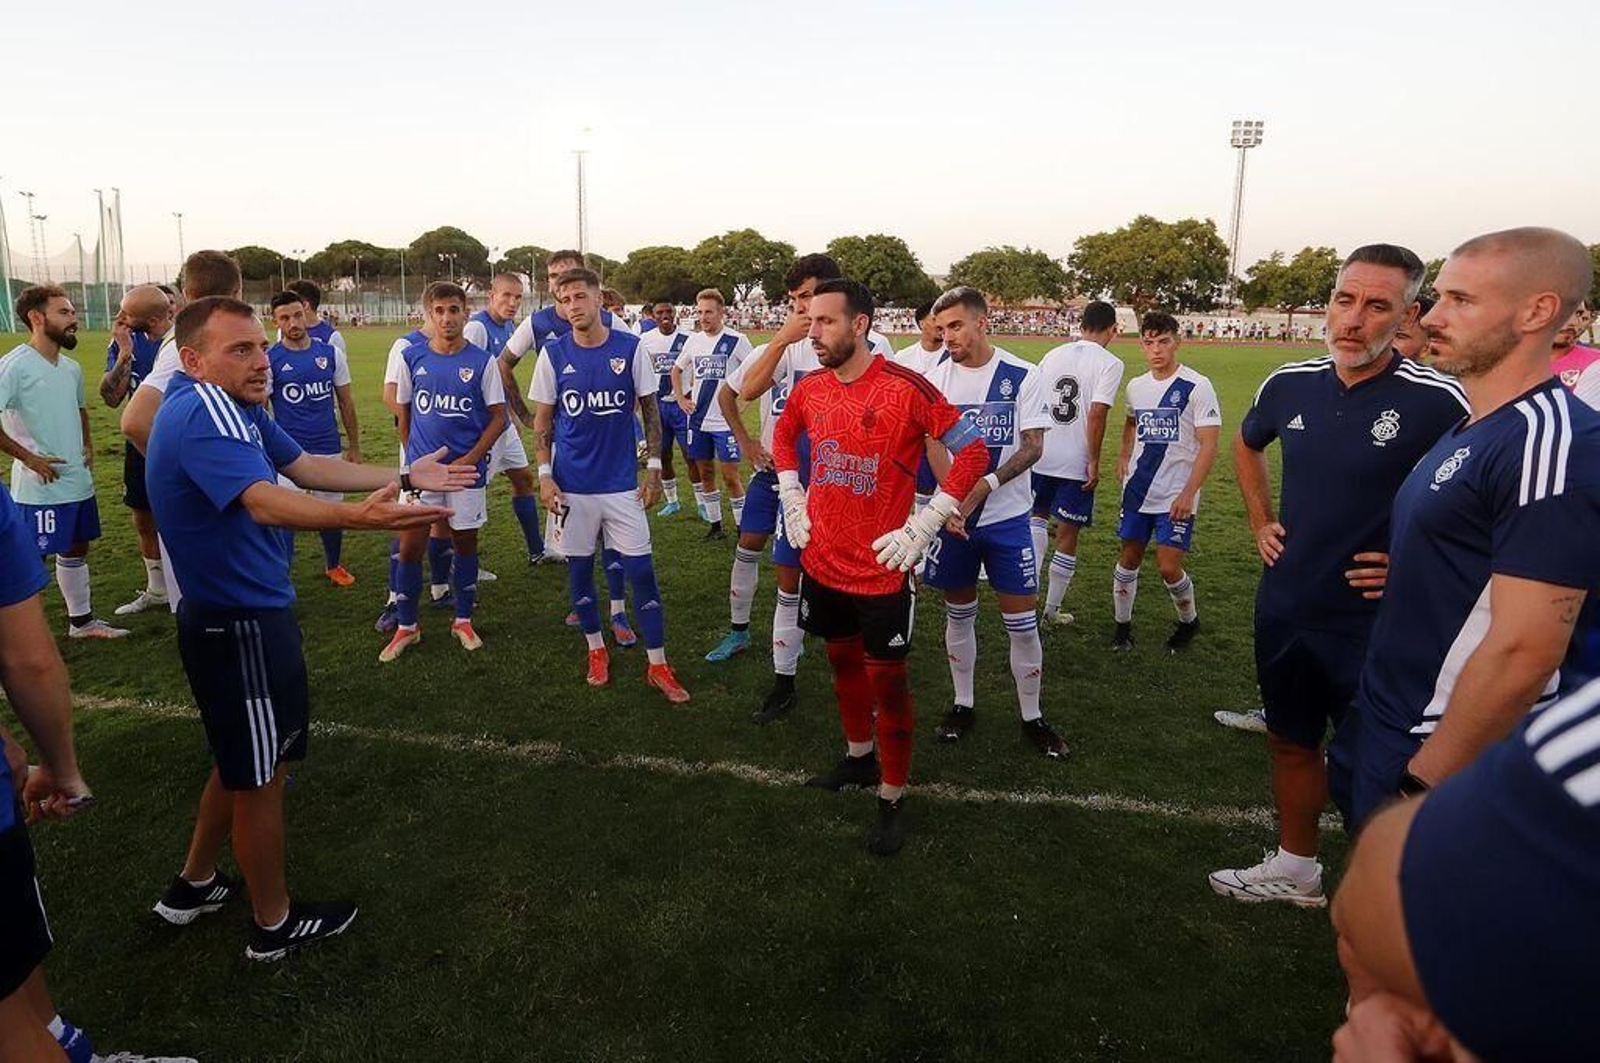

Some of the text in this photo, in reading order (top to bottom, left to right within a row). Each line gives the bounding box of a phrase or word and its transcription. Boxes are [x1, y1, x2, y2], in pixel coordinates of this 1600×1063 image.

[435, 394, 473, 412] MLC
[587, 390, 626, 407] MLC
[1050, 375, 1080, 425] 3
[34, 509, 56, 534] 16
